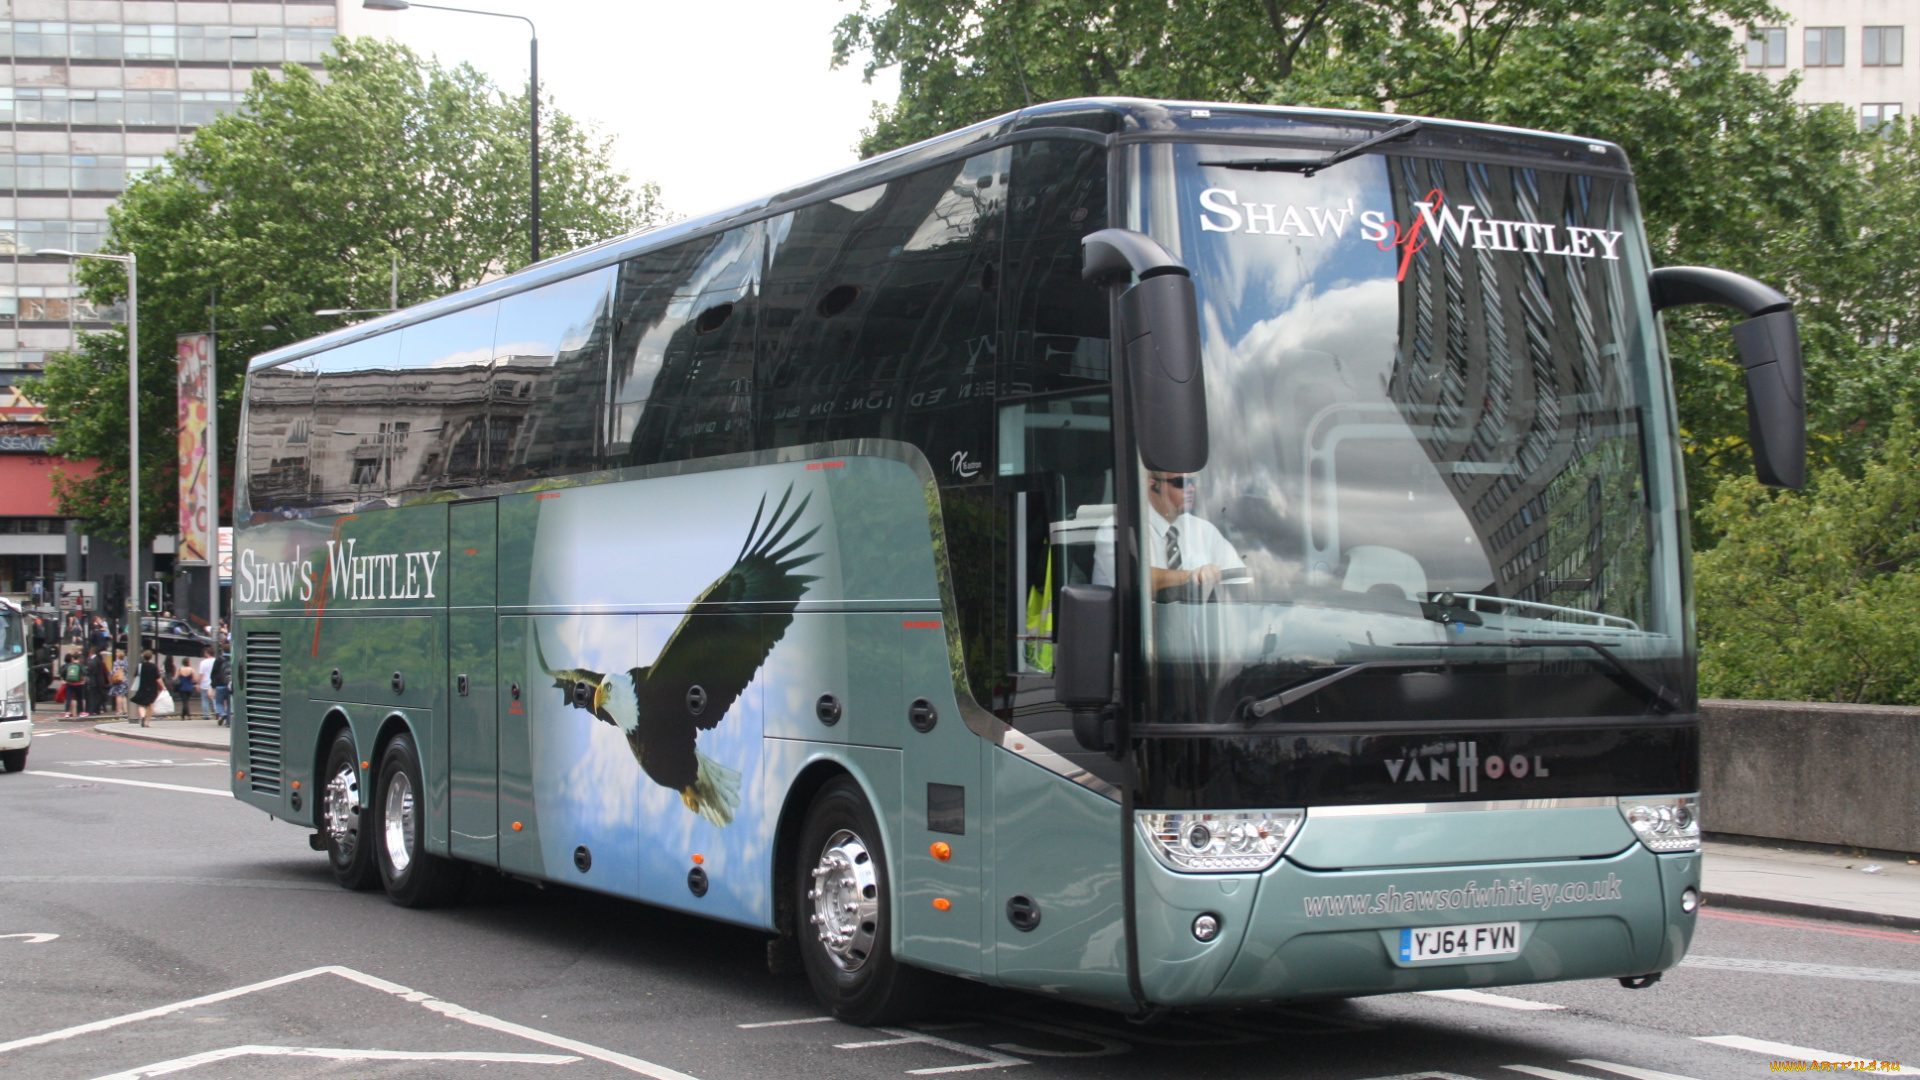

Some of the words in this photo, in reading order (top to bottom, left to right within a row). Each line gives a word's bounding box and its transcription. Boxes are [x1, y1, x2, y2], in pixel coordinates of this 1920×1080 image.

[1373, 188, 1443, 282] of
[1414, 201, 1624, 260] WHITLEY
[326, 538, 441, 600] WHITLEY
[1303, 872, 1623, 917] www.shawsofwhitley.co.uk
[1415, 929, 1469, 957] YJ64
[1475, 924, 1517, 952] FVN
